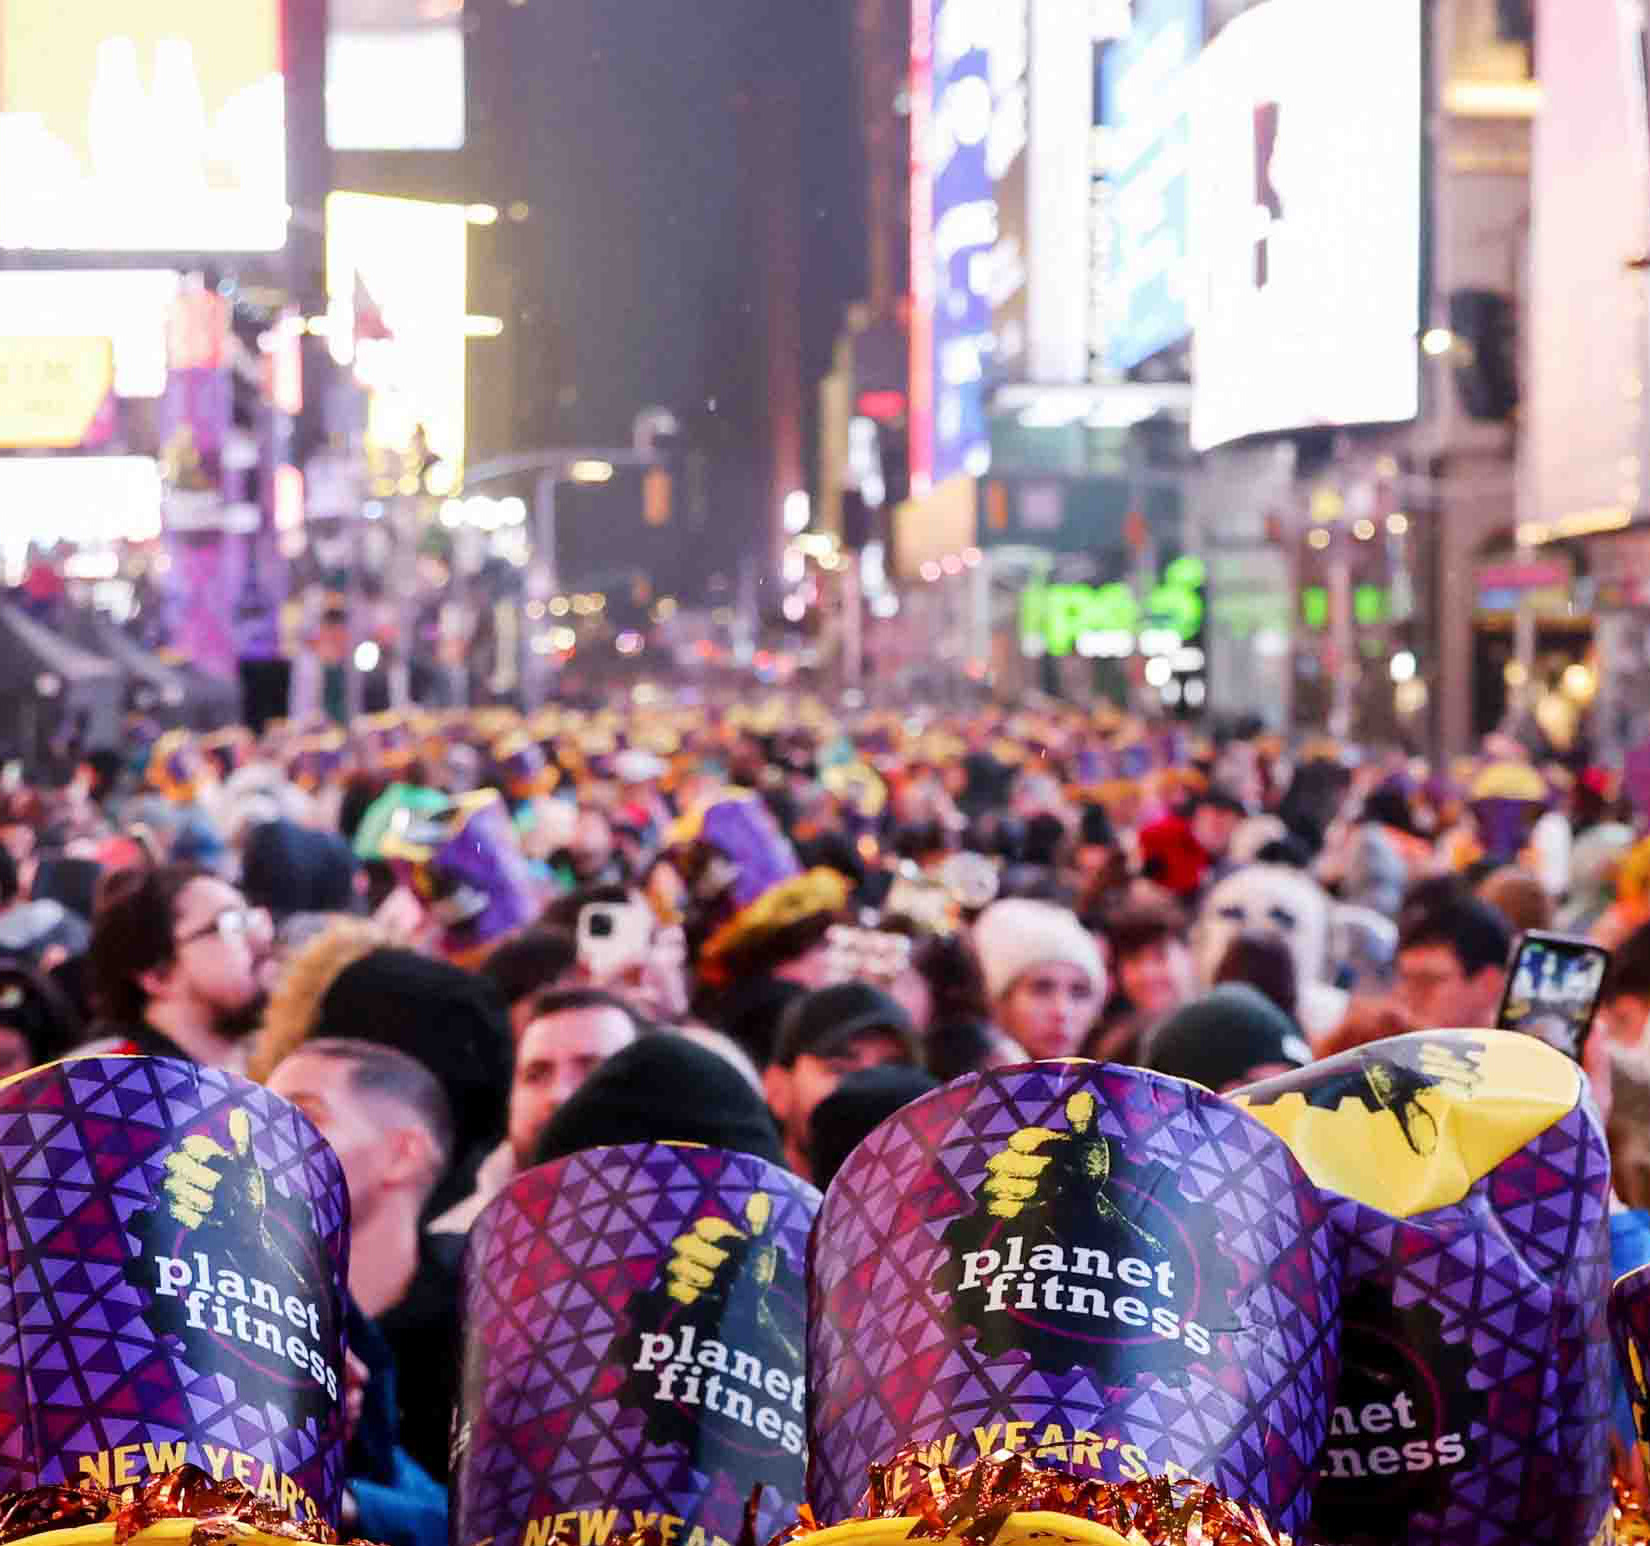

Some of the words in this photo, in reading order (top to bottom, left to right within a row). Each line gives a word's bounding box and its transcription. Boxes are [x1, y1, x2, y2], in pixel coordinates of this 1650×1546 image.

[154, 1254, 320, 1340] planet
[957, 1236, 1175, 1300] planet
[185, 1292, 339, 1401] fitness
[983, 1271, 1212, 1356] fitness
[634, 1325, 807, 1414] planet
[654, 1361, 808, 1458] fitnes
[1329, 1391, 1417, 1435] net
[78, 1441, 187, 1492] NEW
[973, 1421, 1149, 1484] YEAR'S
[1319, 1432, 1466, 1478] ness
